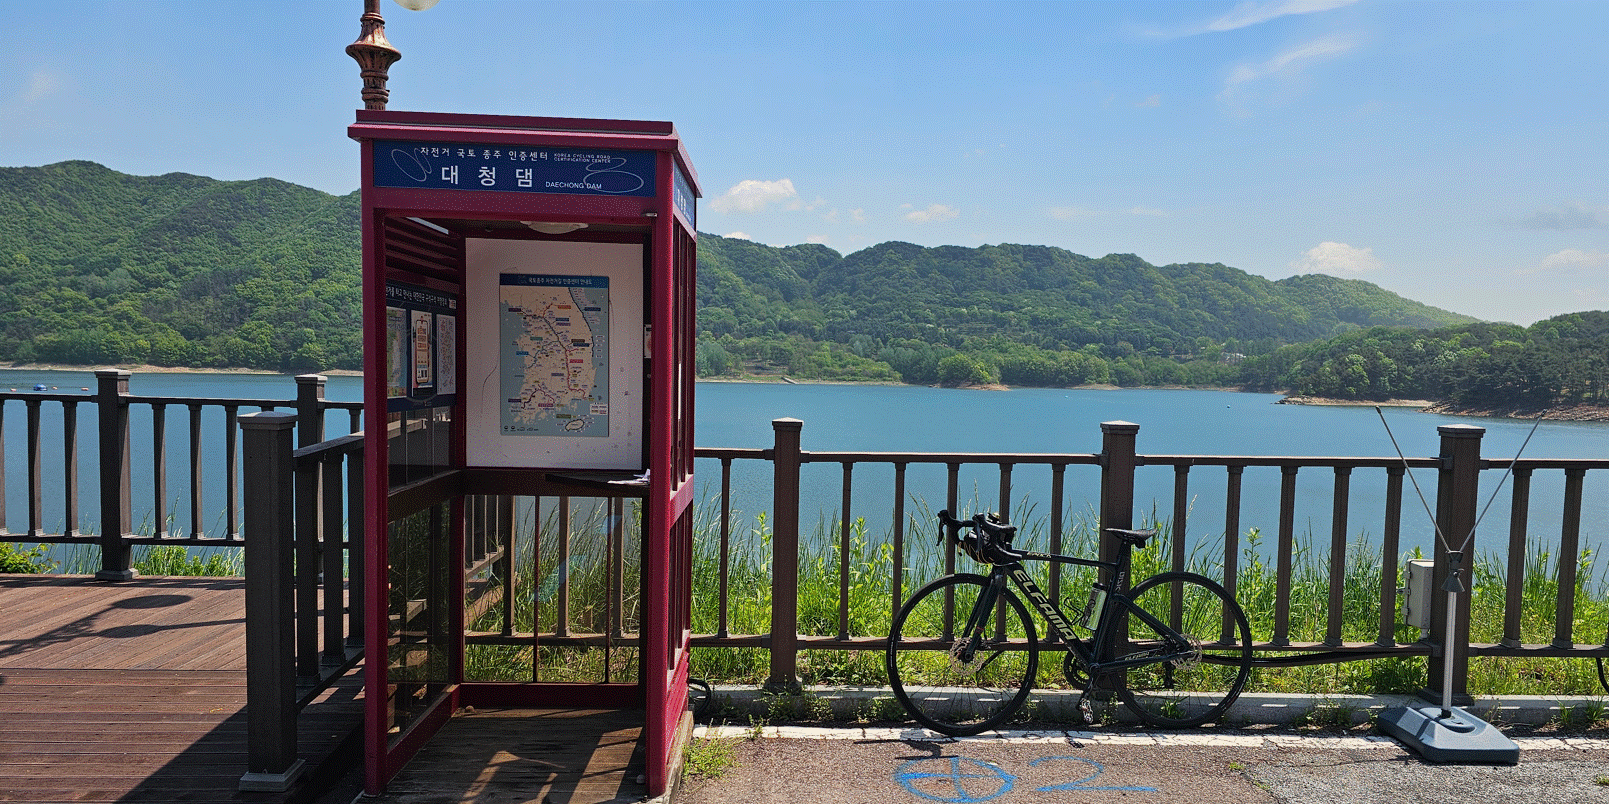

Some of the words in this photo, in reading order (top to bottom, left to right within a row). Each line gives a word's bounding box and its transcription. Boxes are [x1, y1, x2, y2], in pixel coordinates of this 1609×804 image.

[420, 147, 450, 158] 자전거
[456, 148, 477, 159] 국토
[482, 149, 502, 160] 종주
[508, 150, 548, 162] 인증센터
[545, 181, 585, 189] DAECHONG
[586, 182, 602, 190] DAM
[1013, 568, 1077, 641] ELFAMA
